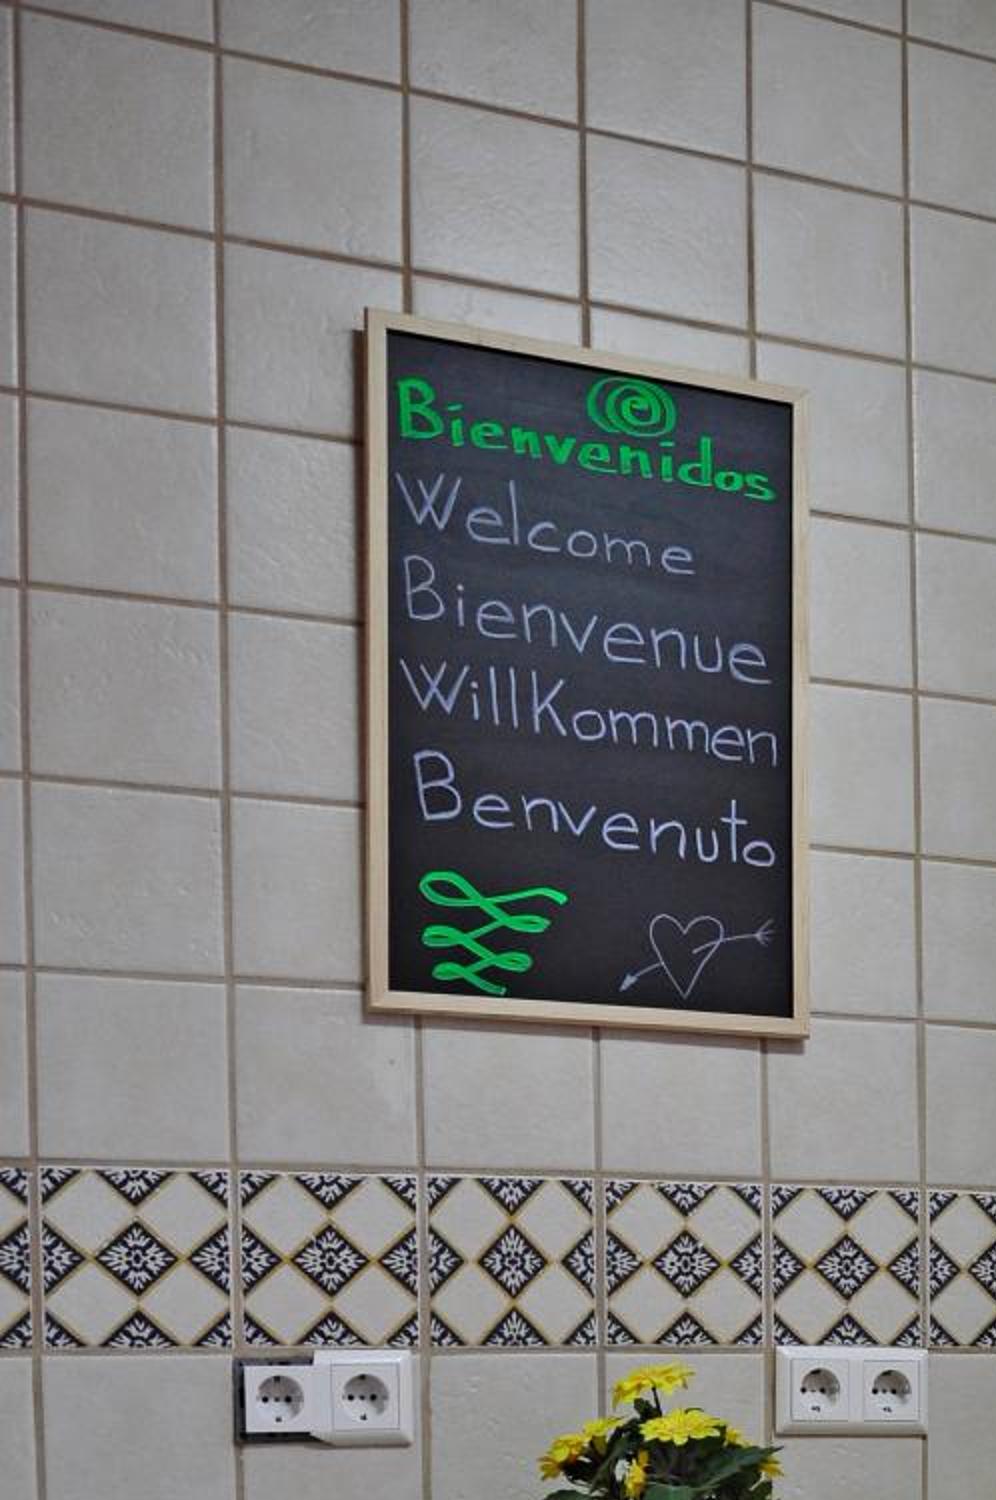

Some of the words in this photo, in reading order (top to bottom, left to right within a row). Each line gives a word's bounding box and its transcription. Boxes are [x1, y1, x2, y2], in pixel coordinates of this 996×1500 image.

[397, 377, 776, 500] Bienvenidos
[396, 473, 696, 575] Welcome
[403, 555, 772, 685] Bienvenue
[413, 750, 776, 867] Benvenuto
